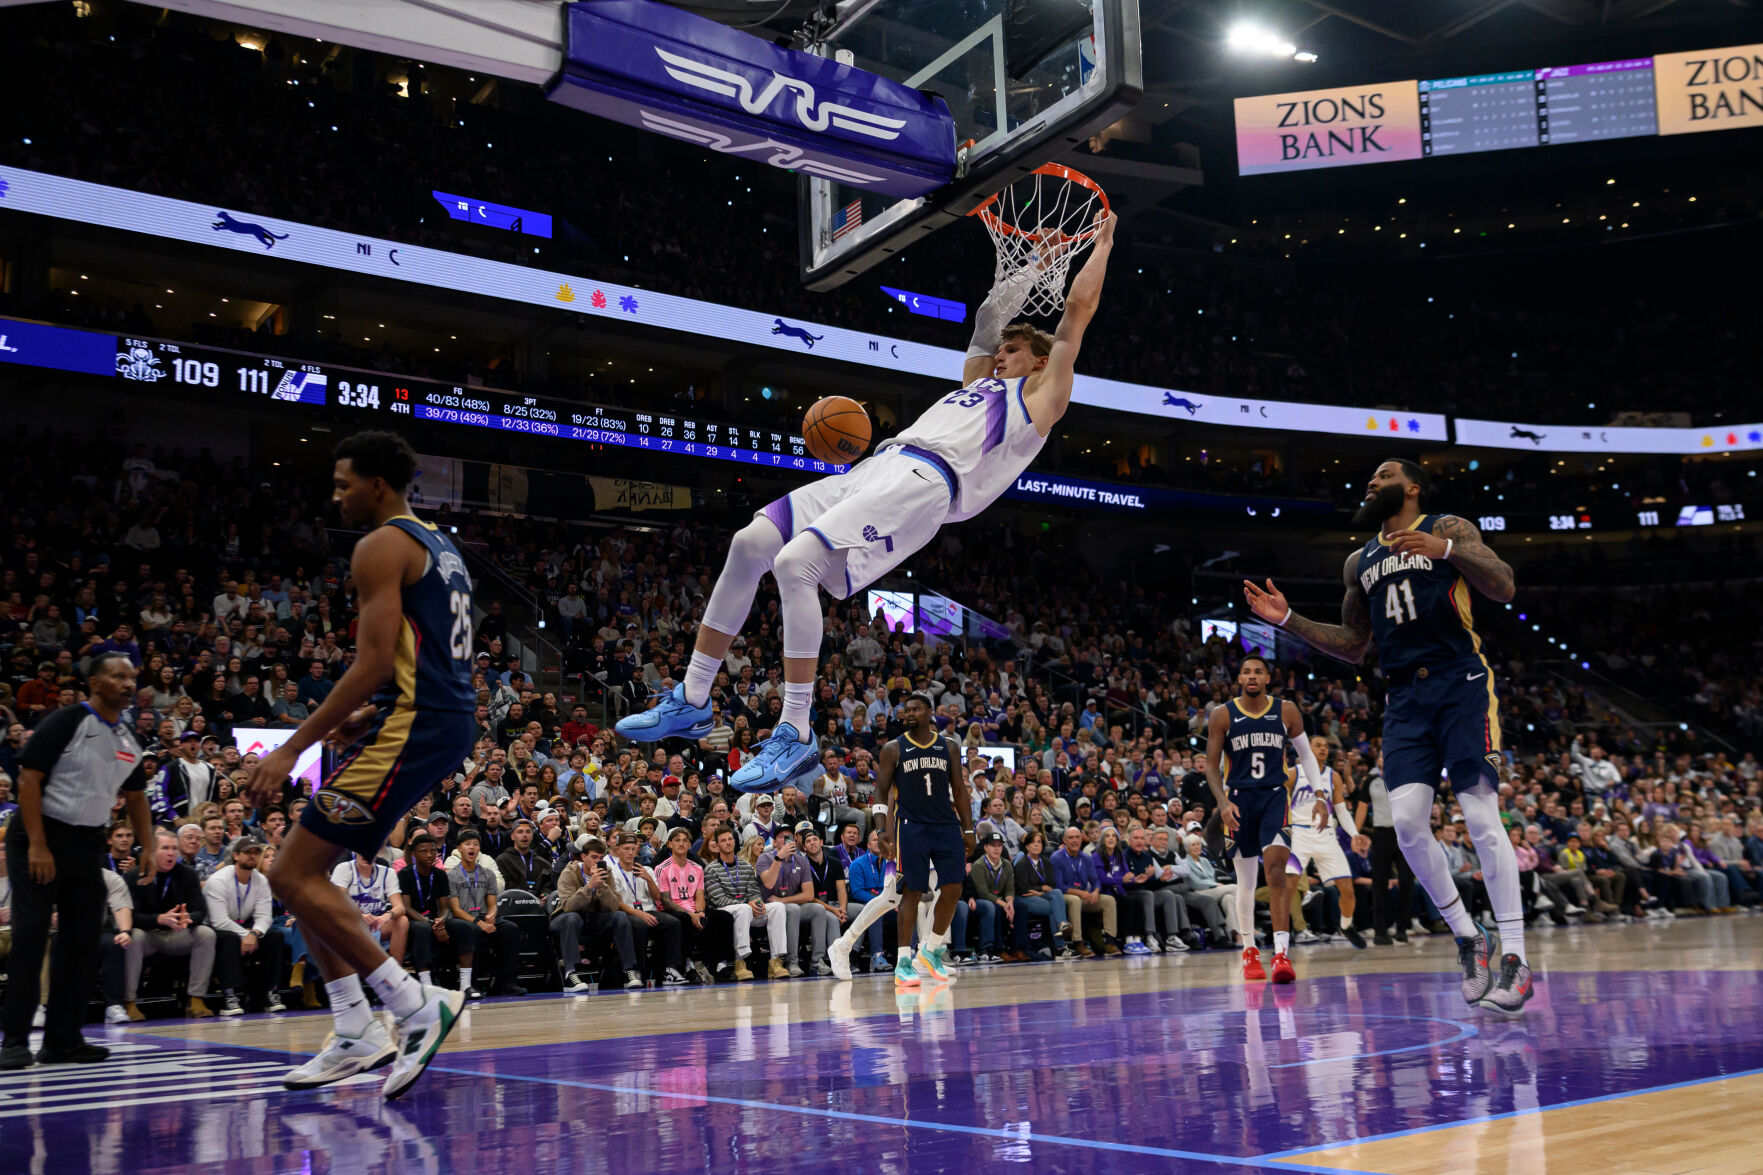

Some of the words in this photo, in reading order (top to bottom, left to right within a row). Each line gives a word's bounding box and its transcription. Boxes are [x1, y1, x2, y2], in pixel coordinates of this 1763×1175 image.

[1276, 93, 1385, 128] ZIONS
[1278, 124, 1387, 161] BANK
[133, 340, 148, 349] FLS
[172, 358, 219, 387] 109
[237, 368, 268, 394] 111
[275, 372, 294, 398] BONUS
[338, 381, 380, 409] 3:34
[395, 388, 409, 400] 13
[943, 389, 985, 408] 23
[390, 403, 410, 414] 4TH
[454, 387, 462, 395] FG
[524, 398, 536, 406] 3PT
[684, 421, 695, 429] REB
[706, 424, 717, 432] AST
[728, 427, 739, 436] STL
[750, 430, 760, 438] BLK
[426, 393, 459, 407] 40/83
[462, 398, 490, 412] (48%)
[503, 404, 528, 416] 8/25
[530, 407, 556, 421] (32%)
[571, 414, 598, 426] 19/23
[600, 418, 626, 431] (83%)
[639, 424, 649, 434] 10
[661, 427, 673, 436] 26
[684, 430, 695, 440] 36
[708, 434, 716, 443] 17
[729, 437, 738, 446] 14
[752, 440, 758, 449] 5
[771, 443, 781, 452] 14
[793, 446, 804, 455] 56
[425, 407, 458, 420] 39/79
[460, 412, 489, 426] (49%)
[500, 418, 529, 430] 12/33
[531, 421, 559, 435] (36%)
[572, 428, 599, 439] 21/29
[601, 431, 626, 444] (72%)
[640, 437, 648, 446] 14
[662, 440, 672, 449] 27
[685, 444, 695, 453] 41
[706, 447, 718, 456] 29
[731, 450, 736, 458] 4
[752, 453, 758, 461] 4
[773, 456, 780, 464] 17
[793, 459, 805, 468] 40
[814, 461, 825, 471] 113
[834, 464, 845, 473] 112
[1017, 478, 1096, 500] LAST-MINUTE
[1097, 491, 1145, 508] TRAVEL.
[1478, 516, 1505, 531] 109
[1637, 511, 1659, 526] 111
[1361, 562, 1380, 595] NEW
[1382, 551, 1433, 576] ORLEANS
[1385, 579, 1417, 625] 41
[450, 590, 473, 661] 25
[1230, 734, 1249, 752] NEW
[1250, 732, 1284, 750] ORLEANS
[903, 757, 919, 774] NEW
[920, 756, 948, 772] ORLEANS
[1251, 752, 1266, 780] 5
[924, 773, 932, 796] 1
